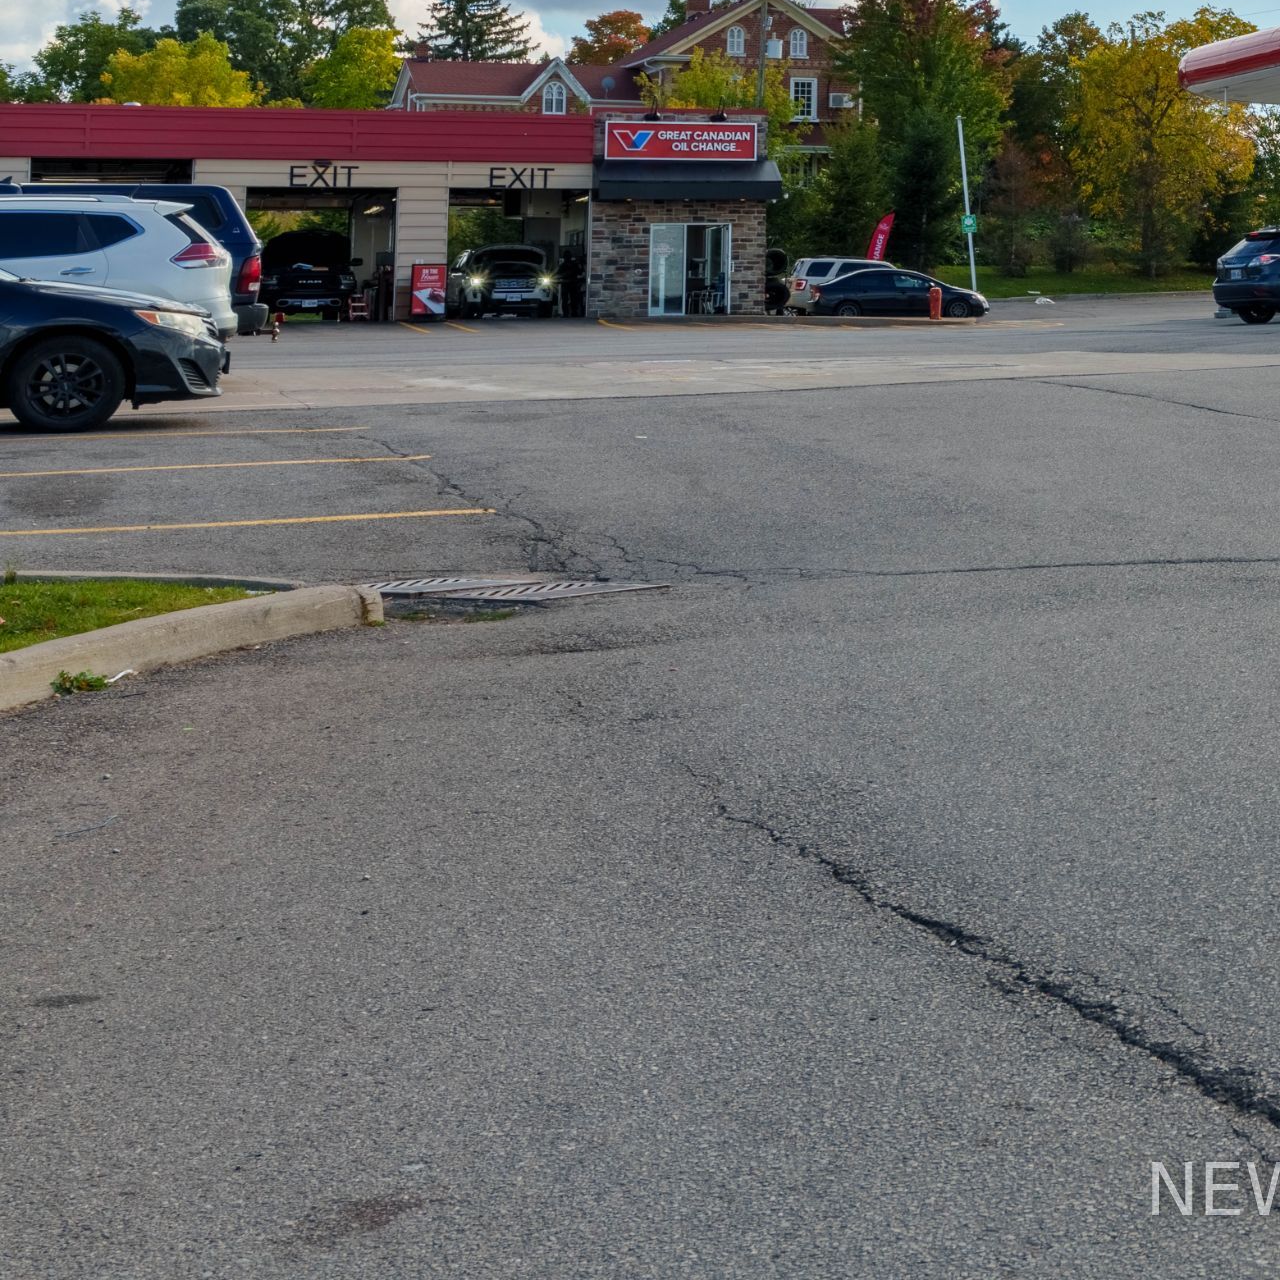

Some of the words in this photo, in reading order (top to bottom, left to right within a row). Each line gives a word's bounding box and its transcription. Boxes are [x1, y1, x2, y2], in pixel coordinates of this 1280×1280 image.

[658, 131, 691, 141] GREAT
[694, 132, 751, 141] CANADIAN
[672, 142, 689, 151] OIL
[691, 142, 737, 151] CHANGE
[289, 165, 359, 188] EXIT
[489, 167, 555, 189] EXIT
